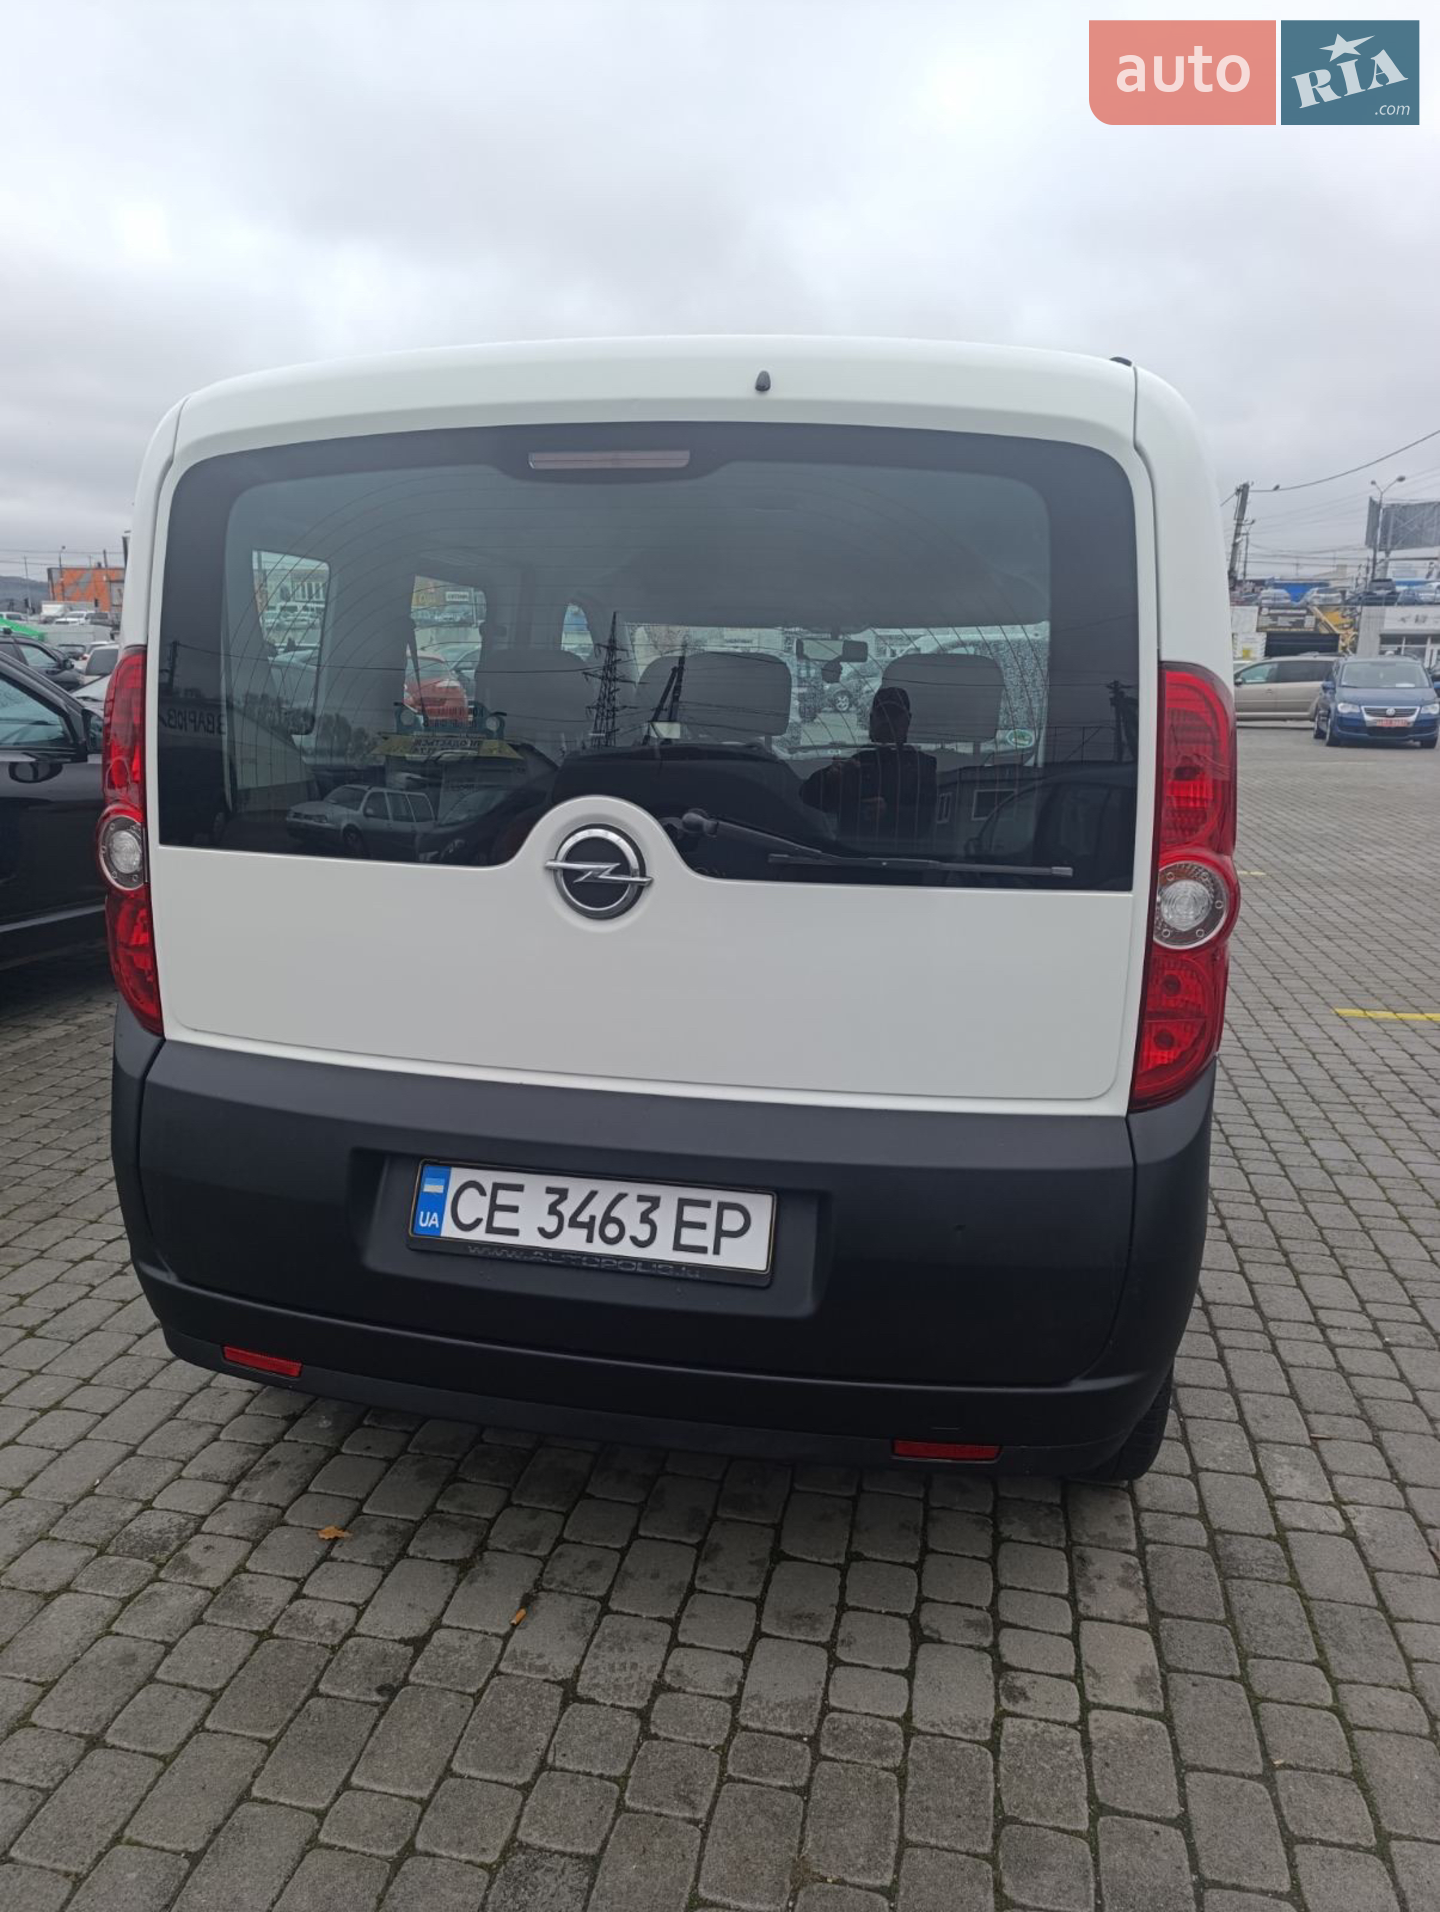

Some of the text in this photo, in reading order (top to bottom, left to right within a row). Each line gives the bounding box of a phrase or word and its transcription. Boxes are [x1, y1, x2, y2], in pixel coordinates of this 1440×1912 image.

[418, 1210, 440, 1229] UA
[450, 1179, 752, 1256] CE 3463 EP
